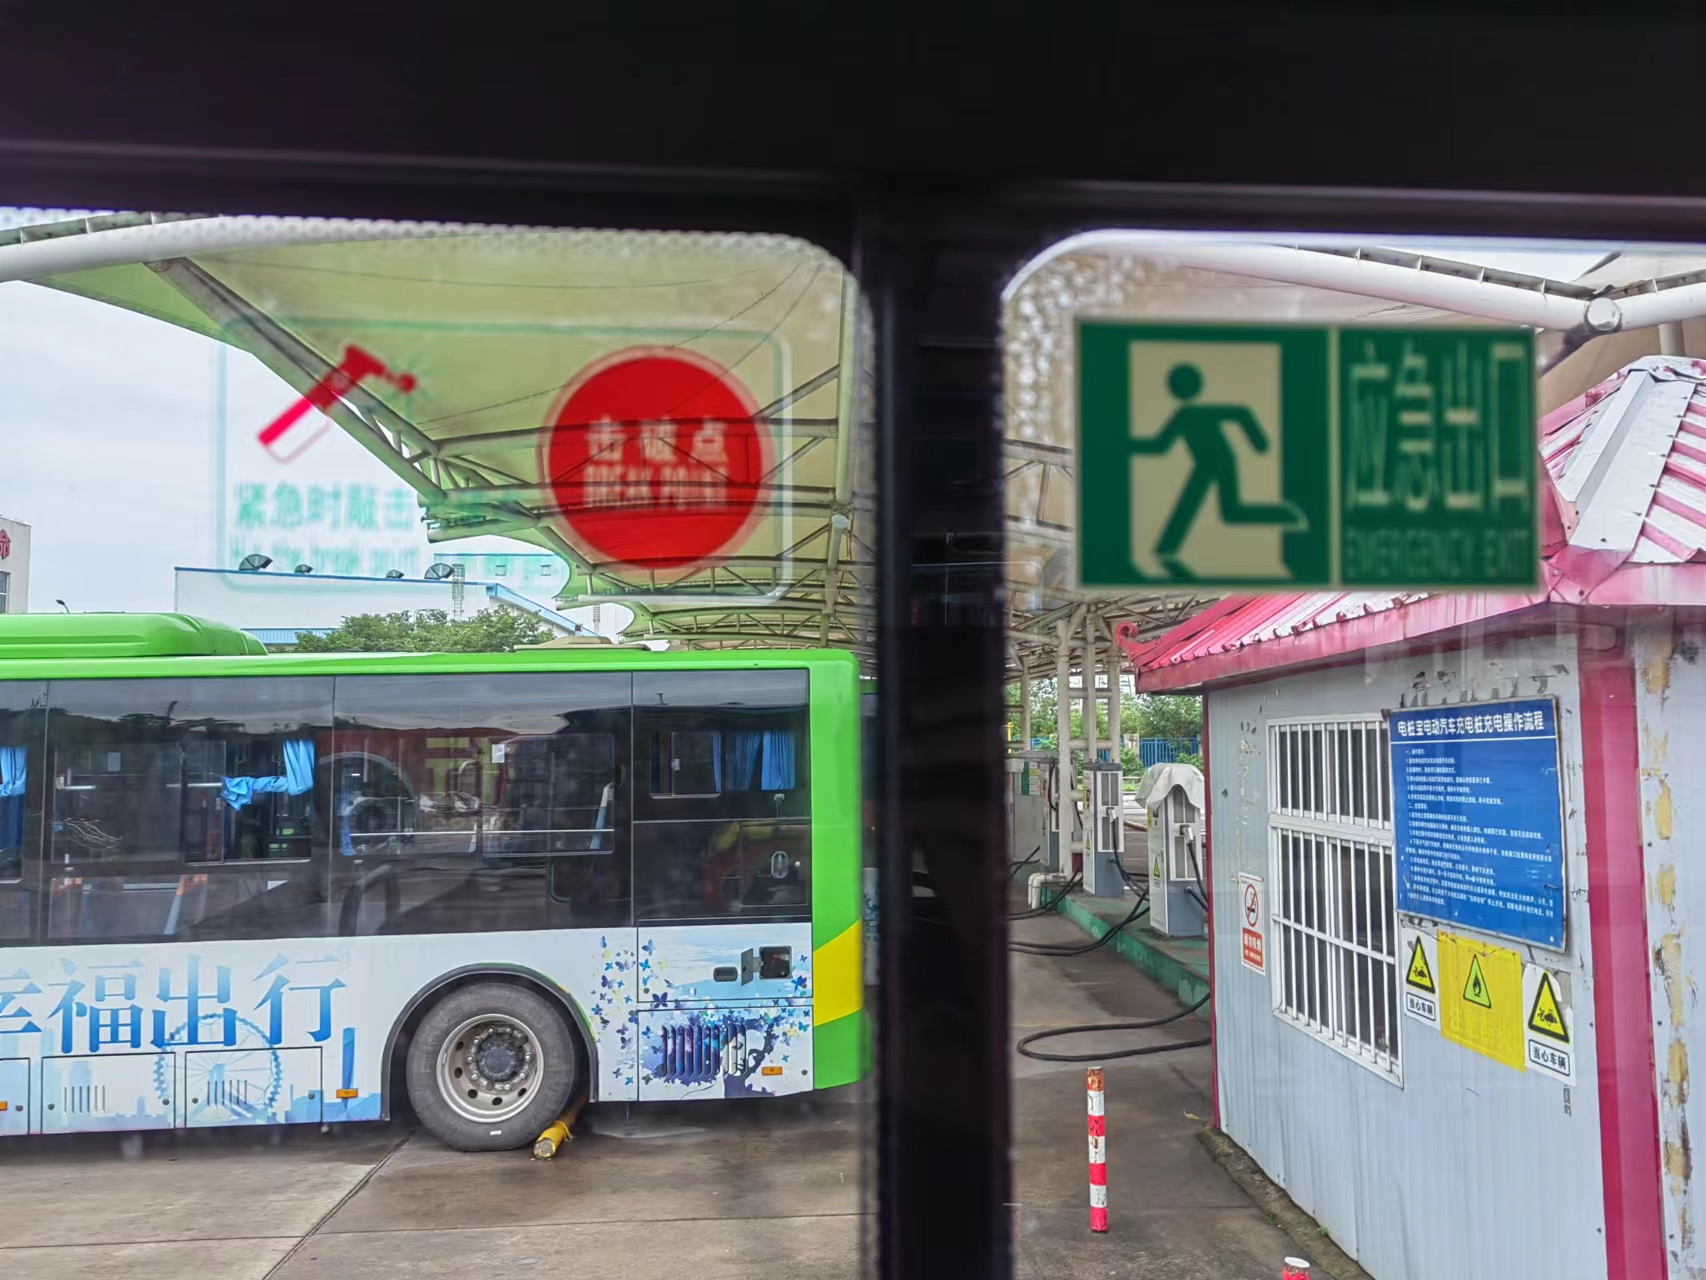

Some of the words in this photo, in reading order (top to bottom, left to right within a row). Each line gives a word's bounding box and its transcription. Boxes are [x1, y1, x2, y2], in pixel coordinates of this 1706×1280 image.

[1347, 339, 1531, 513] 应急出口
[1345, 525, 1473, 578] EMERGENCY
[1484, 525, 1531, 578] EXIT
[1397, 711, 1545, 737] 电桩宝电动汽车充电桩充电操作流程
[1409, 997, 1434, 1018] 当心车辆
[1532, 1046, 1567, 1071] 当心车辆
